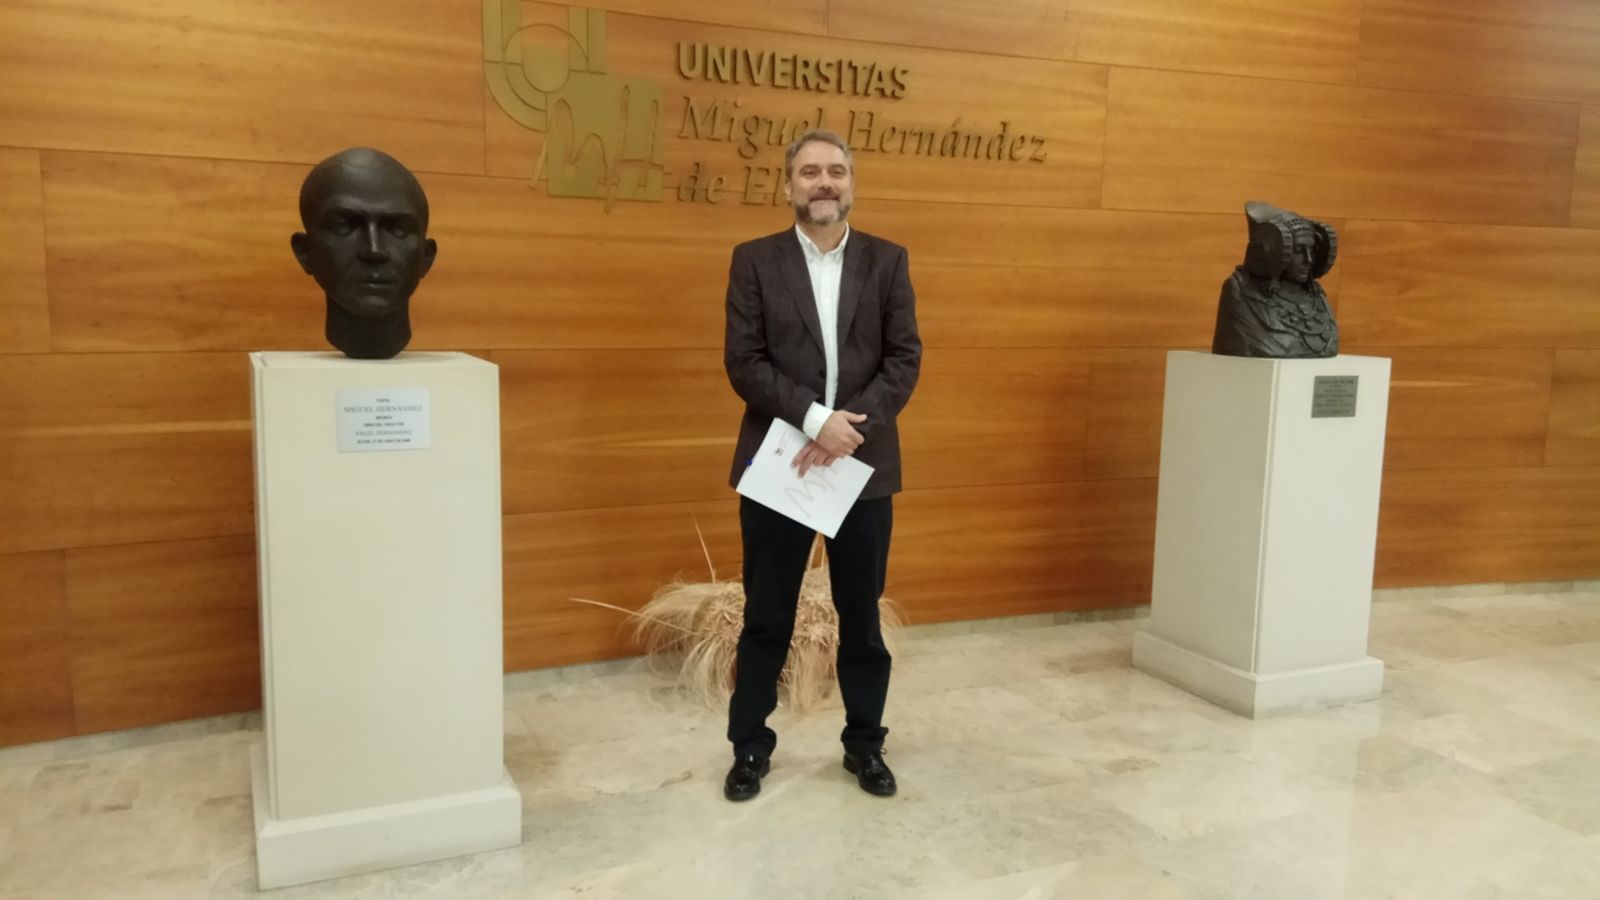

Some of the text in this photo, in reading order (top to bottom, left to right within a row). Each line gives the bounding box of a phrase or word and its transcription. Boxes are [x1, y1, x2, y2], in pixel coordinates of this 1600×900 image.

[676, 40, 909, 99] UNIVERSITAS
[846, 109, 1048, 164] Hernández
[675, 161, 724, 205] de
